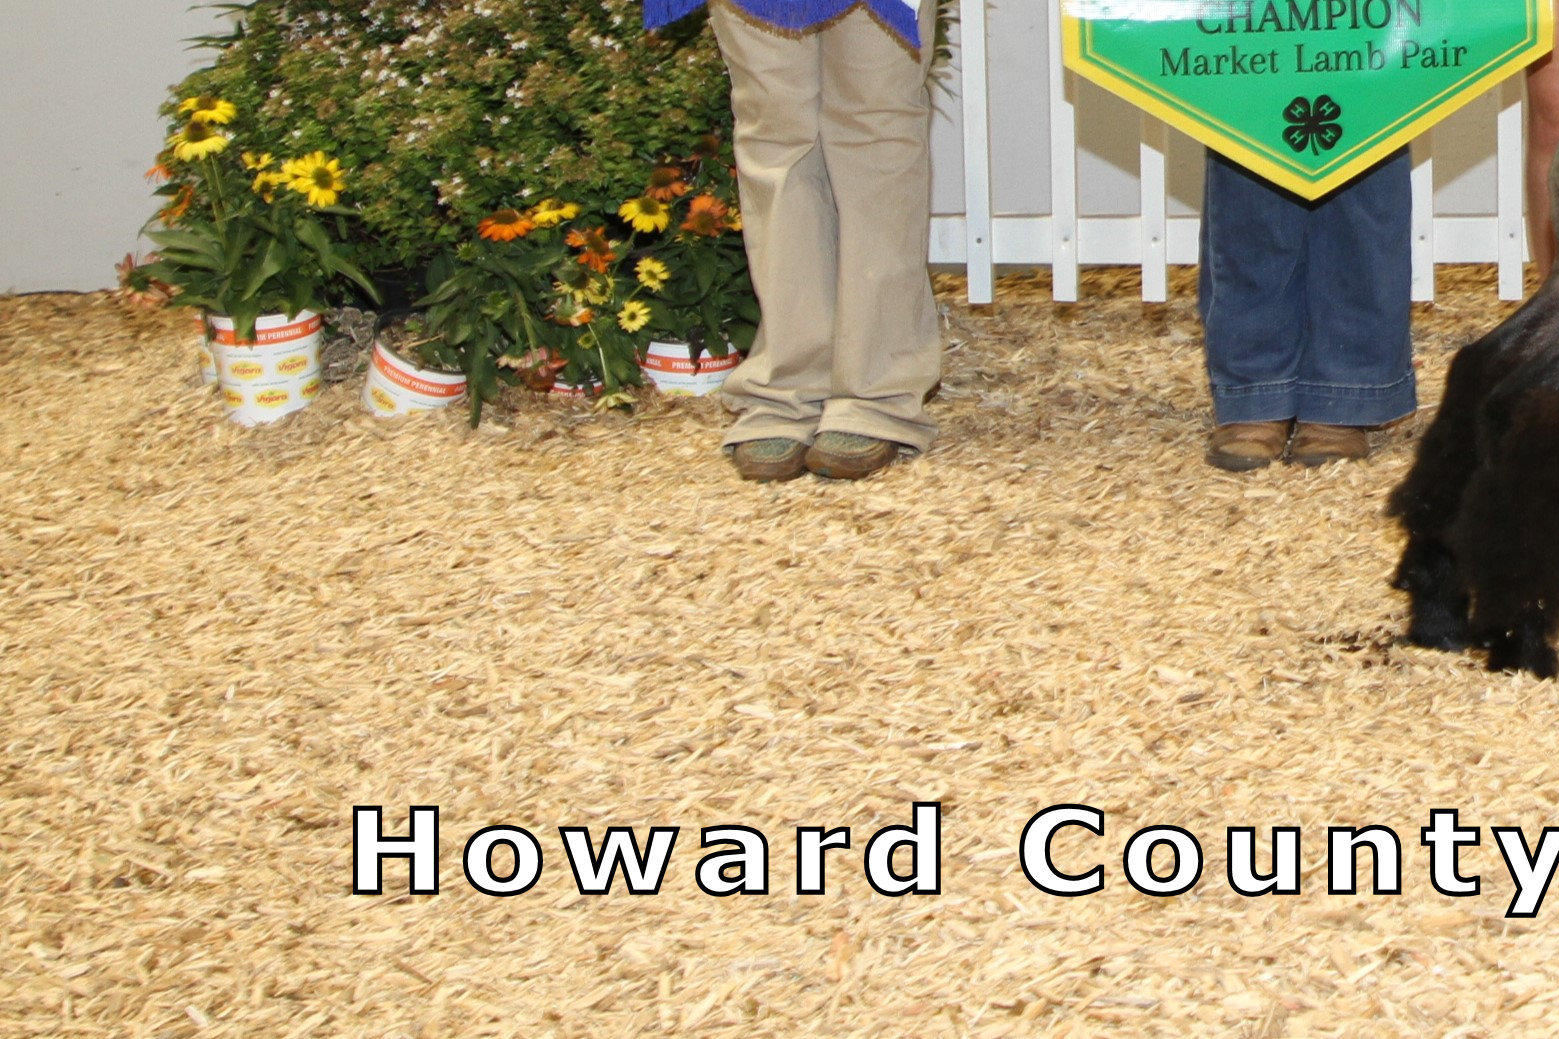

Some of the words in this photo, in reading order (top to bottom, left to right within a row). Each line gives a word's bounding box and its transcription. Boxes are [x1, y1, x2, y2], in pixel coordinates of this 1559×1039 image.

[1158, 43, 1280, 78] Market
[1293, 42, 1387, 74] Lamb
[1399, 39, 1469, 71] Pair
[256, 392, 289, 404] Vigoro
